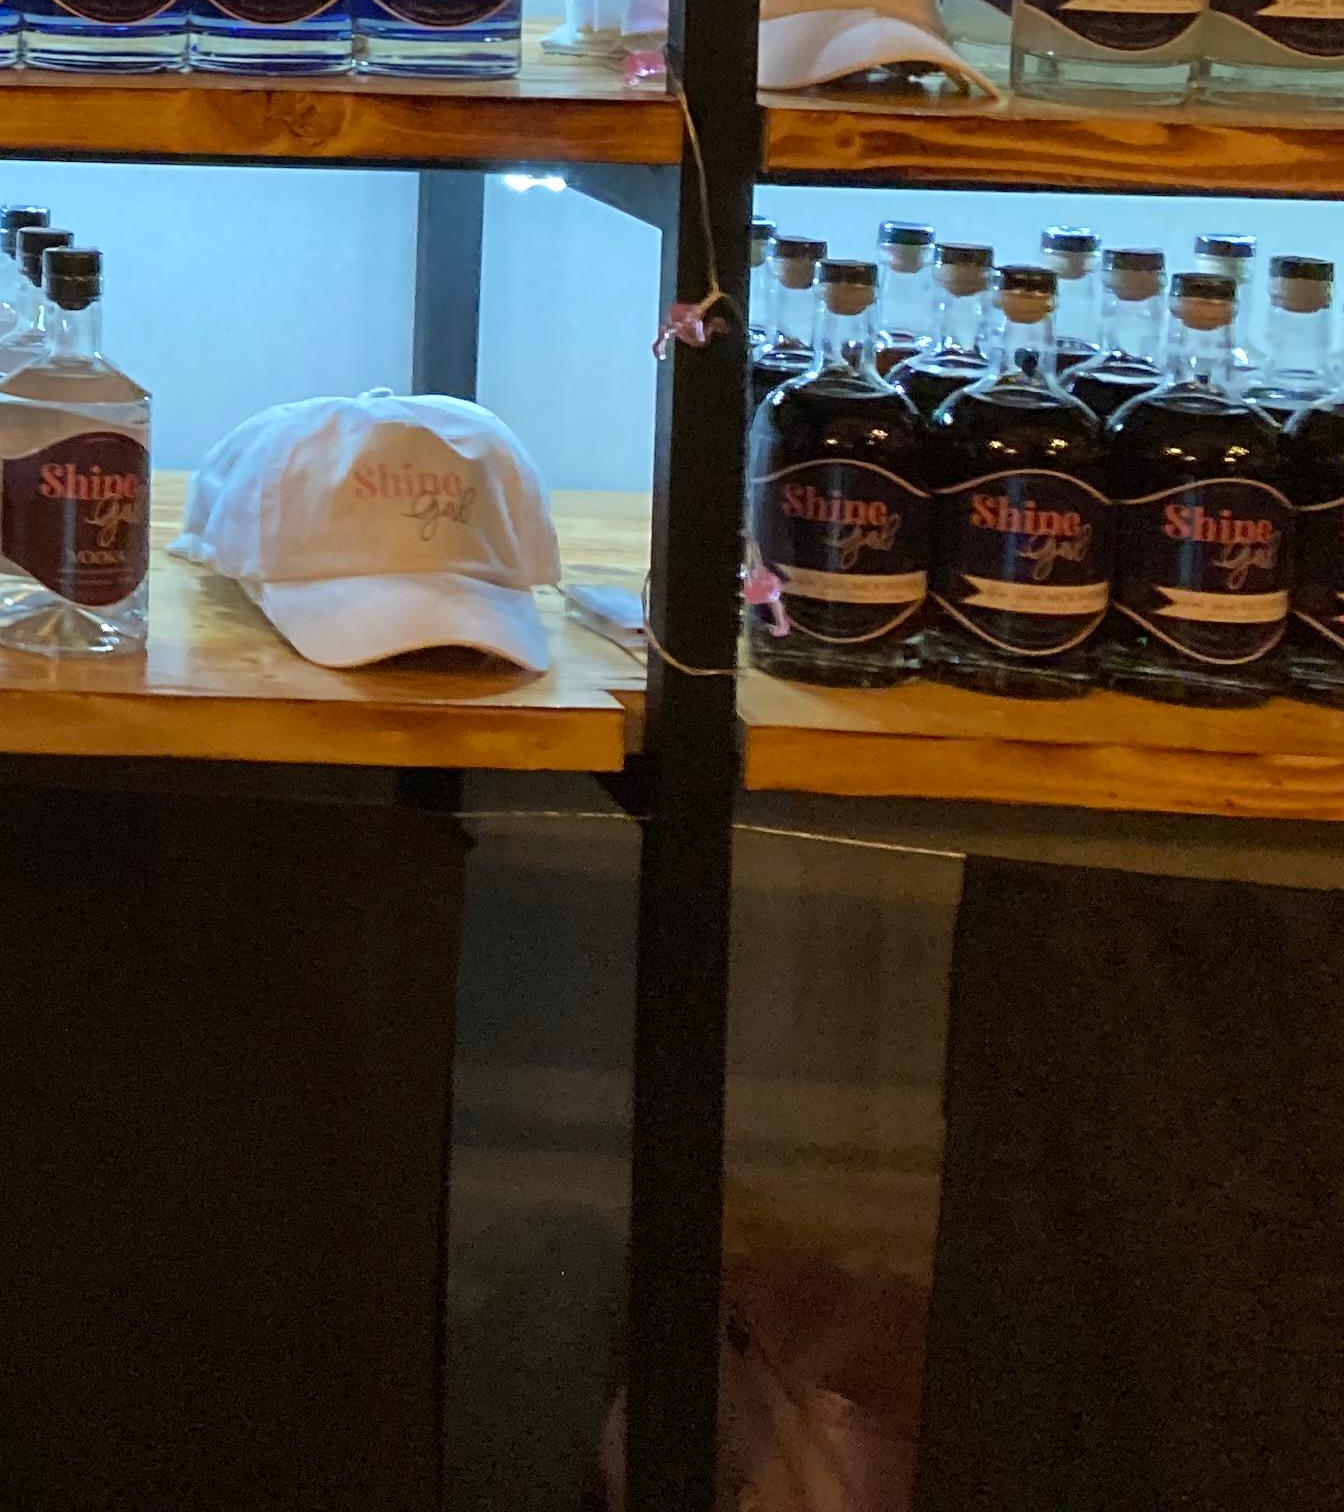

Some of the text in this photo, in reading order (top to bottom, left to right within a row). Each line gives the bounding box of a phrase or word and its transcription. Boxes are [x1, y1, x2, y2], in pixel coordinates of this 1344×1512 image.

[40, 463, 140, 502] Shine
[352, 459, 464, 499] Shine
[781, 485, 888, 525] Shine
[969, 494, 1082, 536] Shine
[1164, 504, 1272, 544] Shine
